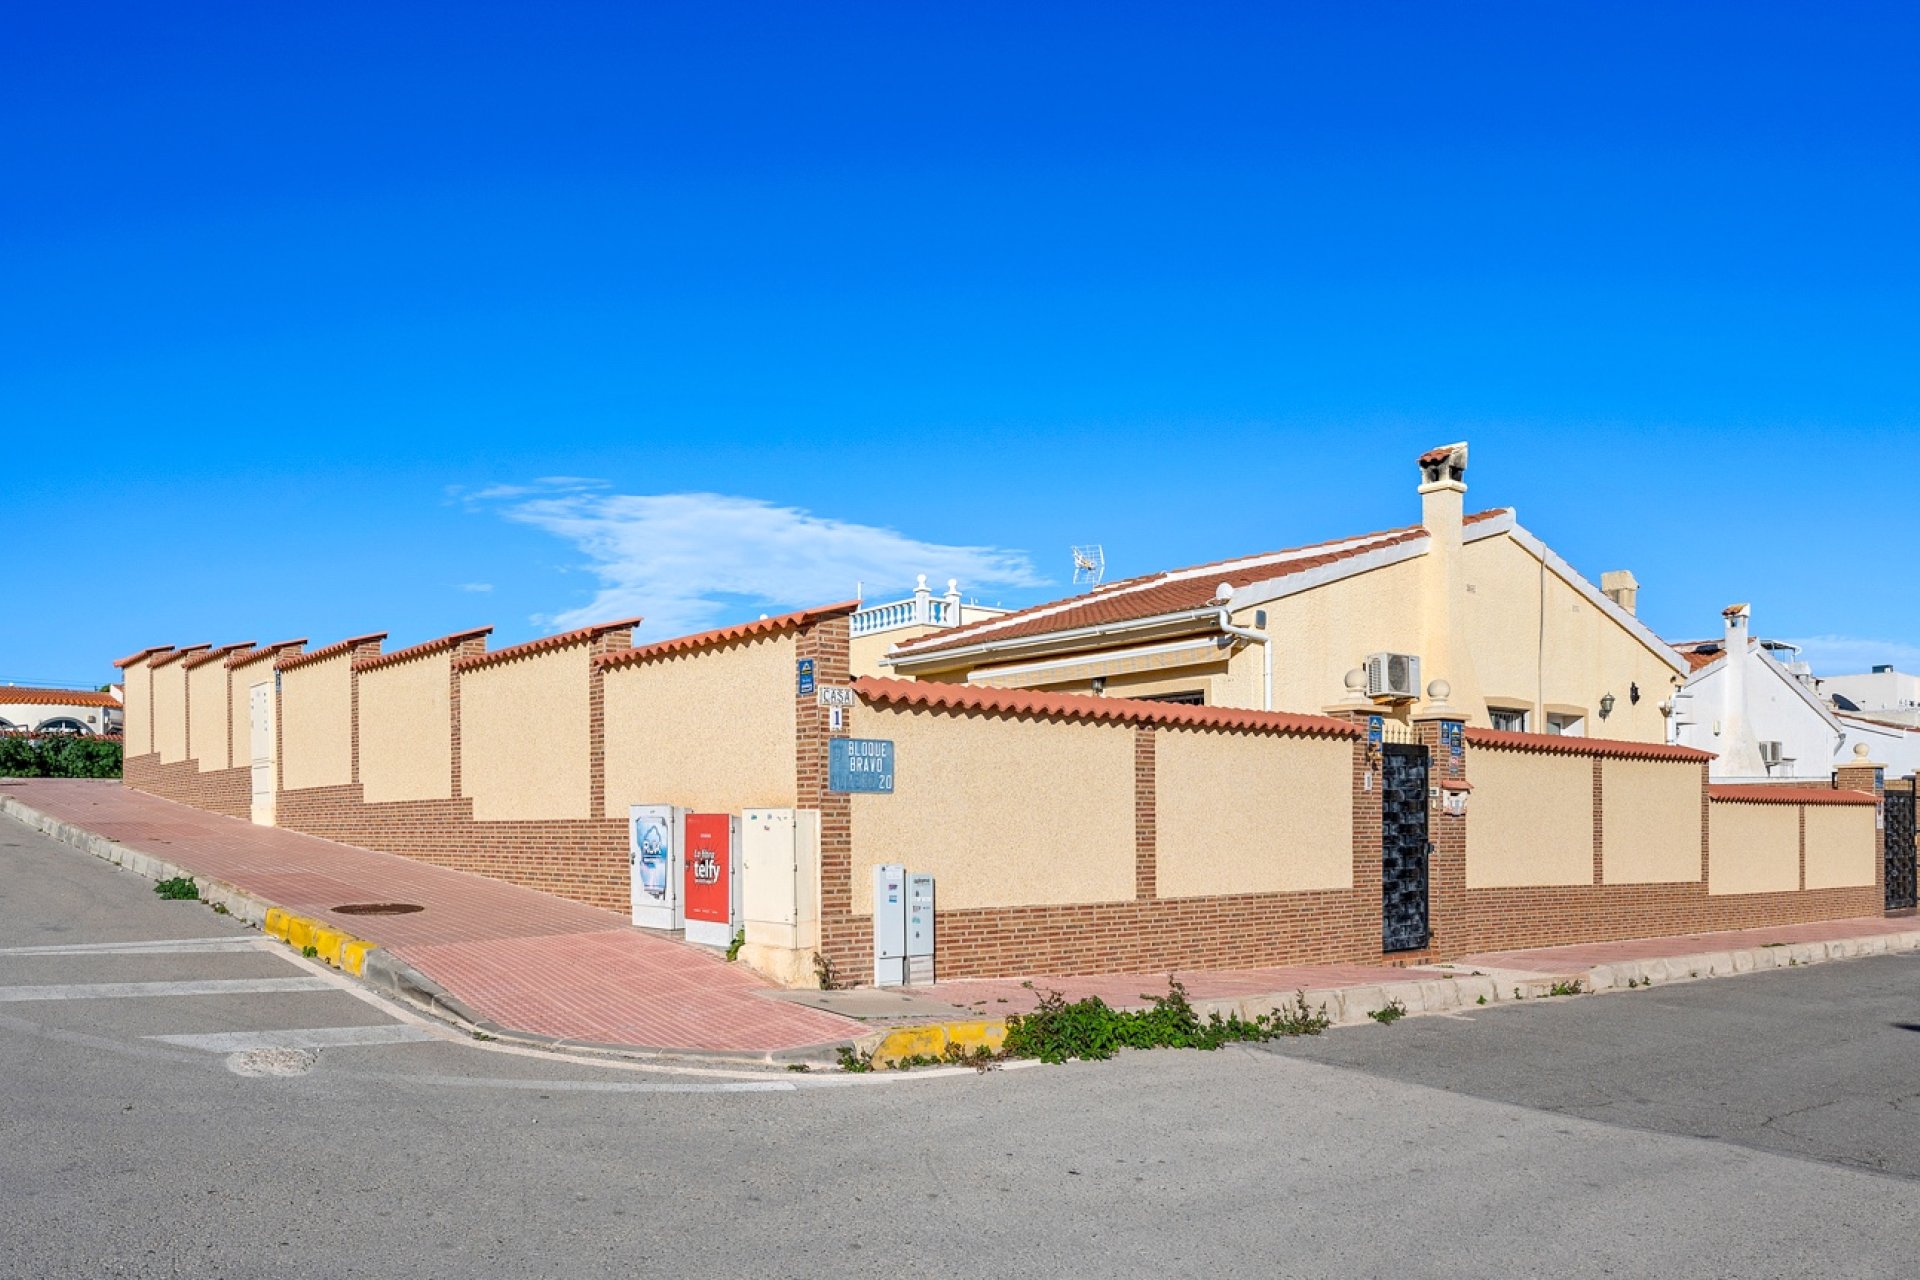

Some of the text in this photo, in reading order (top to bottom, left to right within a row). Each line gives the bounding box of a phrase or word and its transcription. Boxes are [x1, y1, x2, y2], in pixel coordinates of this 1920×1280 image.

[823, 687, 850, 702] CASA
[834, 711, 840, 725] 1
[848, 740, 886, 756] BLOQUE
[850, 757, 883, 772] BRAVO
[878, 774, 892, 789] 20
[694, 858, 720, 883] telfy
